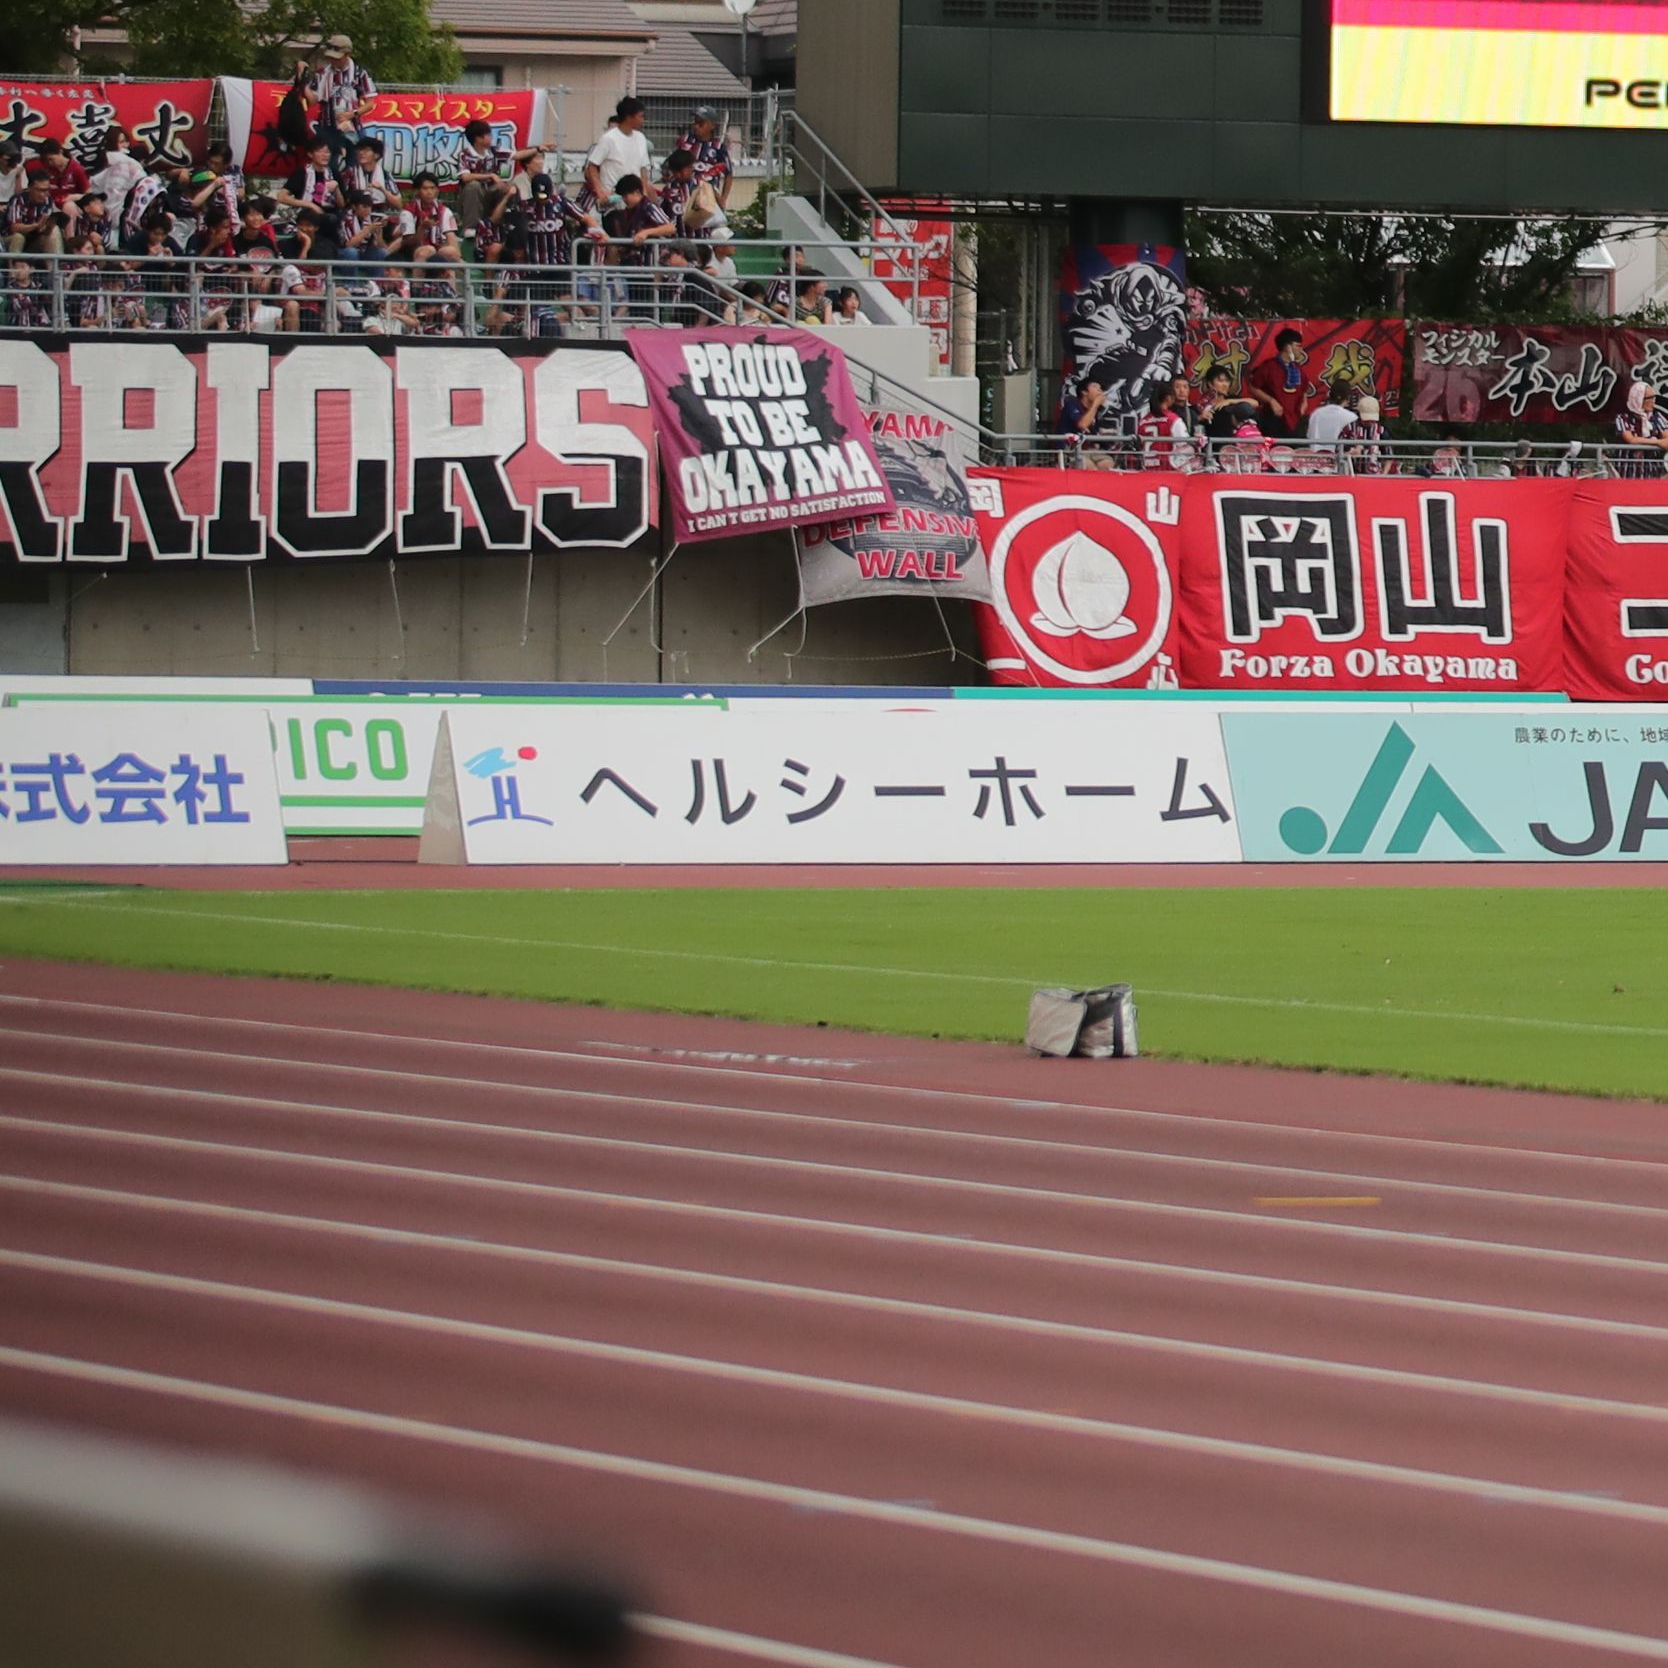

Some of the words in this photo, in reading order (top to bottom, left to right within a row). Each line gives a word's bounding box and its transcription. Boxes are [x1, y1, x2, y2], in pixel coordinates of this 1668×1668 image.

[1421, 347, 1507, 367] モンスター
[1422, 329, 1501, 348] フィジカル
[682, 342, 807, 398] PROUD
[1412, 367, 1481, 422] 26
[704, 398, 764, 447] TO
[759, 398, 822, 448] BE
[678, 440, 884, 515] OKAYAMA
[687, 519, 697, 533] I
[740, 508, 767, 523] GET
[769, 505, 789, 521] NO
[790, 491, 887, 517] SATISFACTION
[855, 548, 966, 581] WALL
[1212, 489, 1513, 645] 岡山
[1219, 647, 1335, 680] Forza
[1345, 647, 1519, 684] Okayama
[269, 717, 409, 782] ICO
[0, 751, 251, 825] 式会社
[579, 755, 1232, 829] ヘルシーホーム
